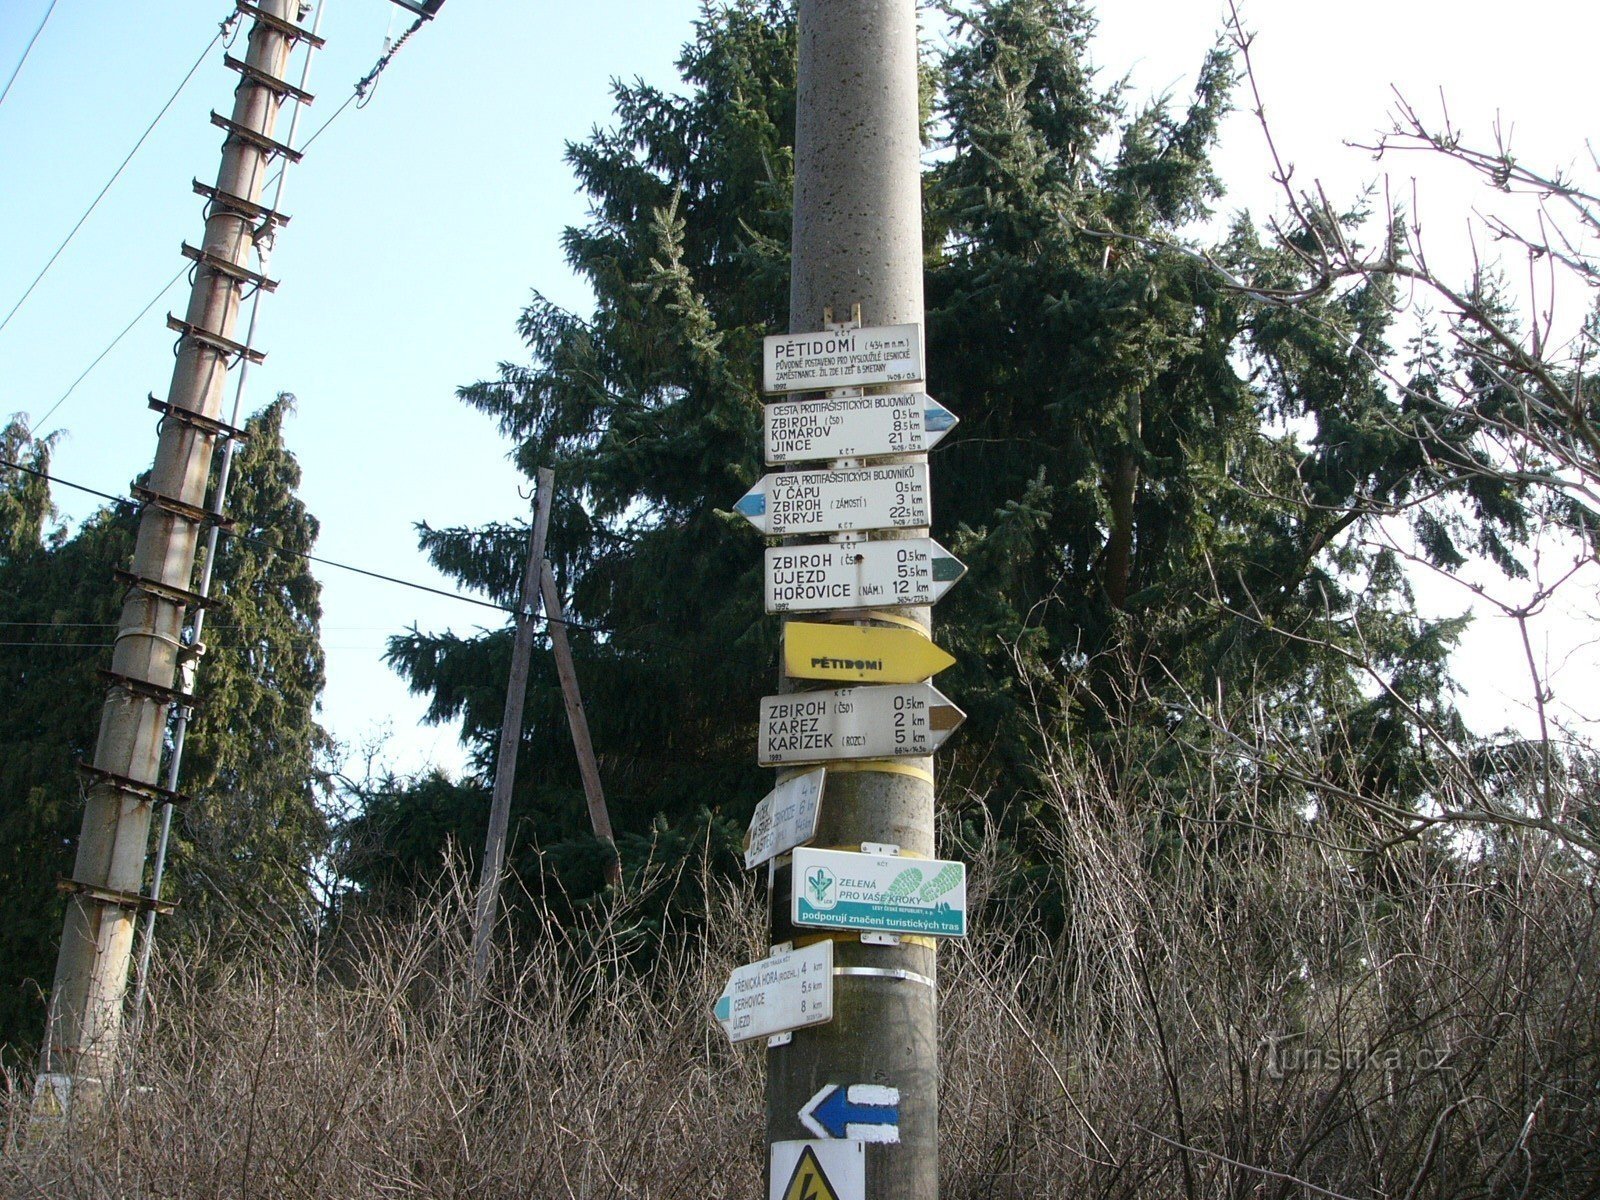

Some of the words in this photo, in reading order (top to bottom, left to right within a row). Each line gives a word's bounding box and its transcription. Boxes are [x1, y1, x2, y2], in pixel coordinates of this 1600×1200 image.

[776, 335, 856, 358] PĚTIDOMÍ
[805, 356, 836, 368] POSTAVENO
[837, 356, 848, 365] PRO
[773, 406, 798, 416] CESTA
[800, 398, 873, 414] PROTIFAŠISTICKÝCH
[875, 395, 916, 408] BOJOVNÍKŮ
[772, 416, 818, 430] ZBIROH
[892, 410, 907, 420] 0.5
[908, 409, 920, 419] km
[772, 426, 831, 440] KOMÁROV
[893, 420, 908, 432] 8.5
[909, 420, 920, 430] km
[772, 440, 812, 453] JINCE
[888, 432, 903, 444] 21
[910, 434, 922, 443] km
[776, 476, 800, 487] CESTA
[802, 470, 872, 485] PROTIFAŠISTICKÝCH
[874, 466, 915, 480] BOJOVNÍKŮ
[772, 489, 781, 500] V
[786, 484, 820, 500] ČÁPU
[895, 482, 909, 493] 0.5
[910, 482, 922, 492] km
[772, 500, 821, 514] ZBIROH
[896, 494, 905, 505] 3
[912, 494, 923, 504] km
[773, 511, 824, 525] SKRYJE
[889, 506, 911, 518] 22.5
[912, 506, 924, 518] km
[772, 554, 832, 570] ZBIROH
[896, 550, 914, 562] 0.5
[914, 550, 927, 561] km
[774, 570, 826, 584] ÚJEZD
[898, 565, 914, 578] 5.5
[916, 566, 928, 577] km
[774, 583, 850, 600] HOŘOVICE
[892, 580, 909, 594] 12
[916, 582, 929, 592] km
[811, 656, 882, 671] PĚTIDOMÍ
[769, 702, 826, 719] ZBIROH
[894, 696, 911, 710] 0.5
[912, 698, 924, 709] km
[768, 717, 818, 735] KAŘEZ
[894, 712, 905, 727] 2
[912, 714, 924, 726] km
[768, 732, 833, 752] KAŘÍZEK
[896, 730, 906, 744] 5
[912, 732, 926, 743] km
[839, 878, 876, 889] ZELENÁ
[840, 891, 860, 900] PRO
[862, 892, 886, 902] VAŠE
[890, 894, 922, 905] KROKY
[802, 911, 847, 923] podporují
[849, 913, 884, 925] značení
[886, 918, 940, 930] turistických
[942, 920, 960, 931] tras
[734, 971, 760, 994] TŘENICKÁ
[761, 970, 778, 988] HORA
[802, 962, 808, 974] 4
[814, 962, 823, 972] km
[734, 992, 765, 1012] CERHOVICE
[812, 982, 823, 990] km
[733, 1014, 750, 1030] ÚJEZD
[801, 1000, 807, 1013] 8
[812, 1001, 822, 1010] km
